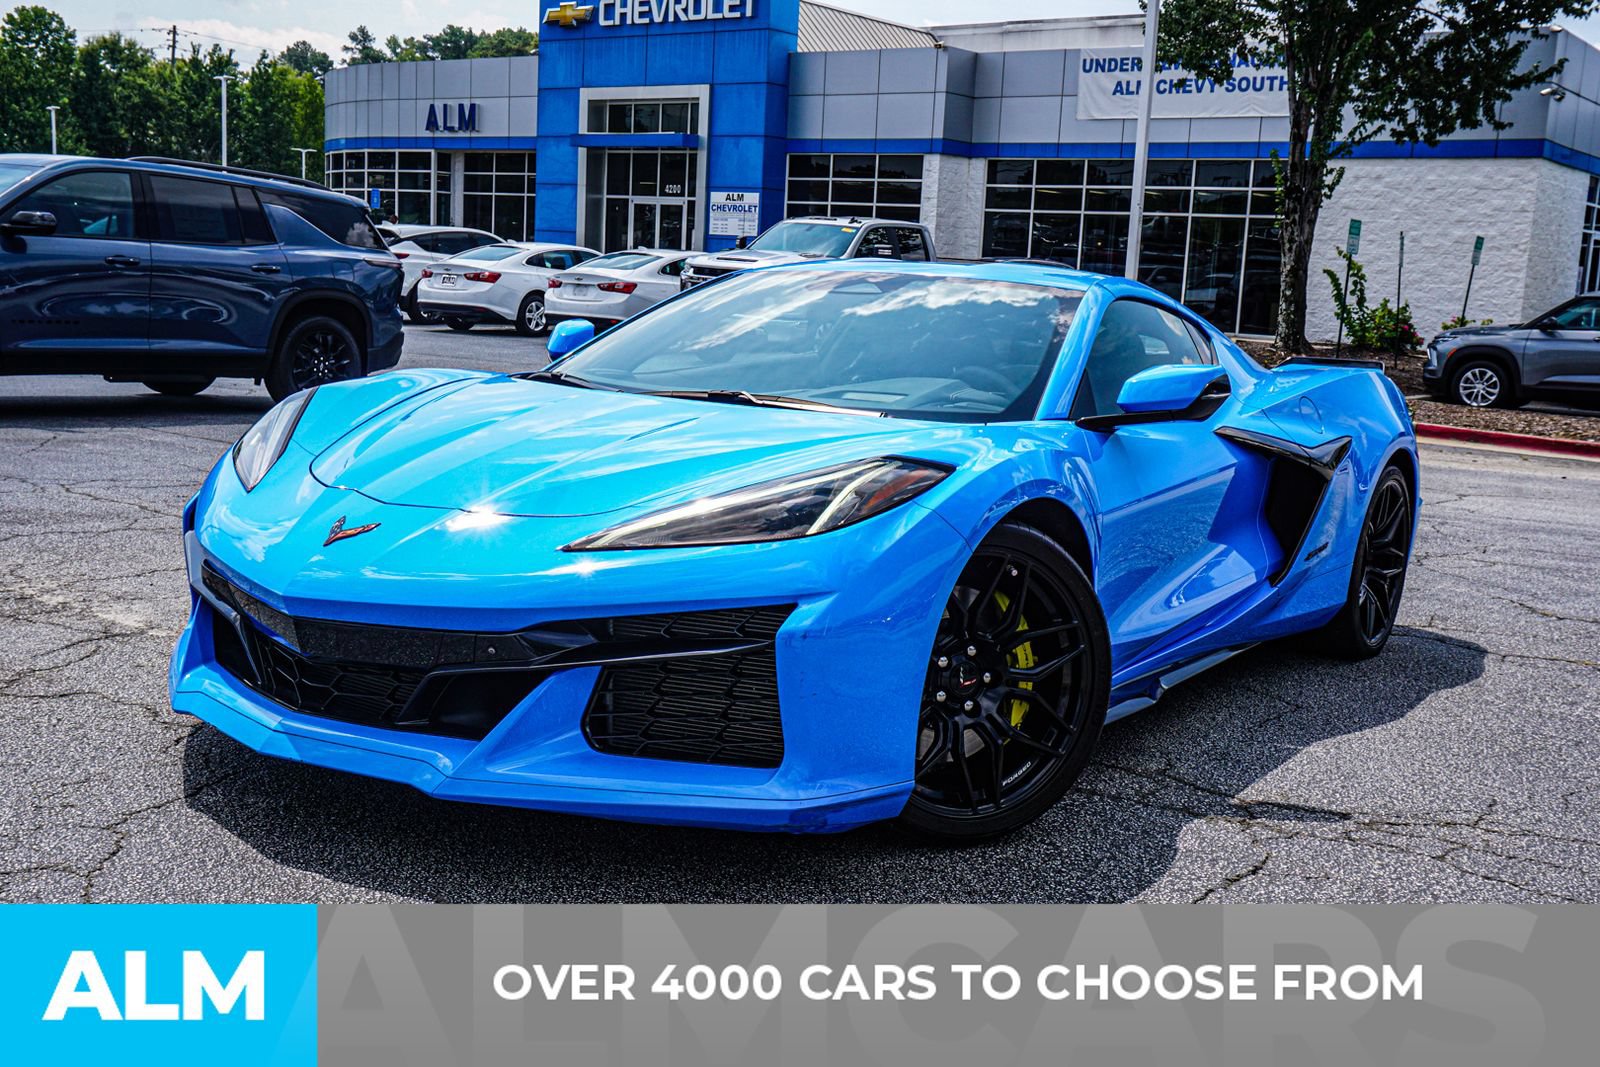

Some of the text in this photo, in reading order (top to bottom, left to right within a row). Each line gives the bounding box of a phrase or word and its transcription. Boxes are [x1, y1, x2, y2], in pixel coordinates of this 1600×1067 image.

[1081, 56, 1143, 73] UNDER
[1155, 76, 1217, 95] CHEVY
[425, 103, 480, 132] ALM
[664, 184, 681, 194] 4200
[725, 193, 744, 202] ALM
[711, 203, 758, 213] CHEVROLET
[1002, 761, 1031, 786] FORGED
